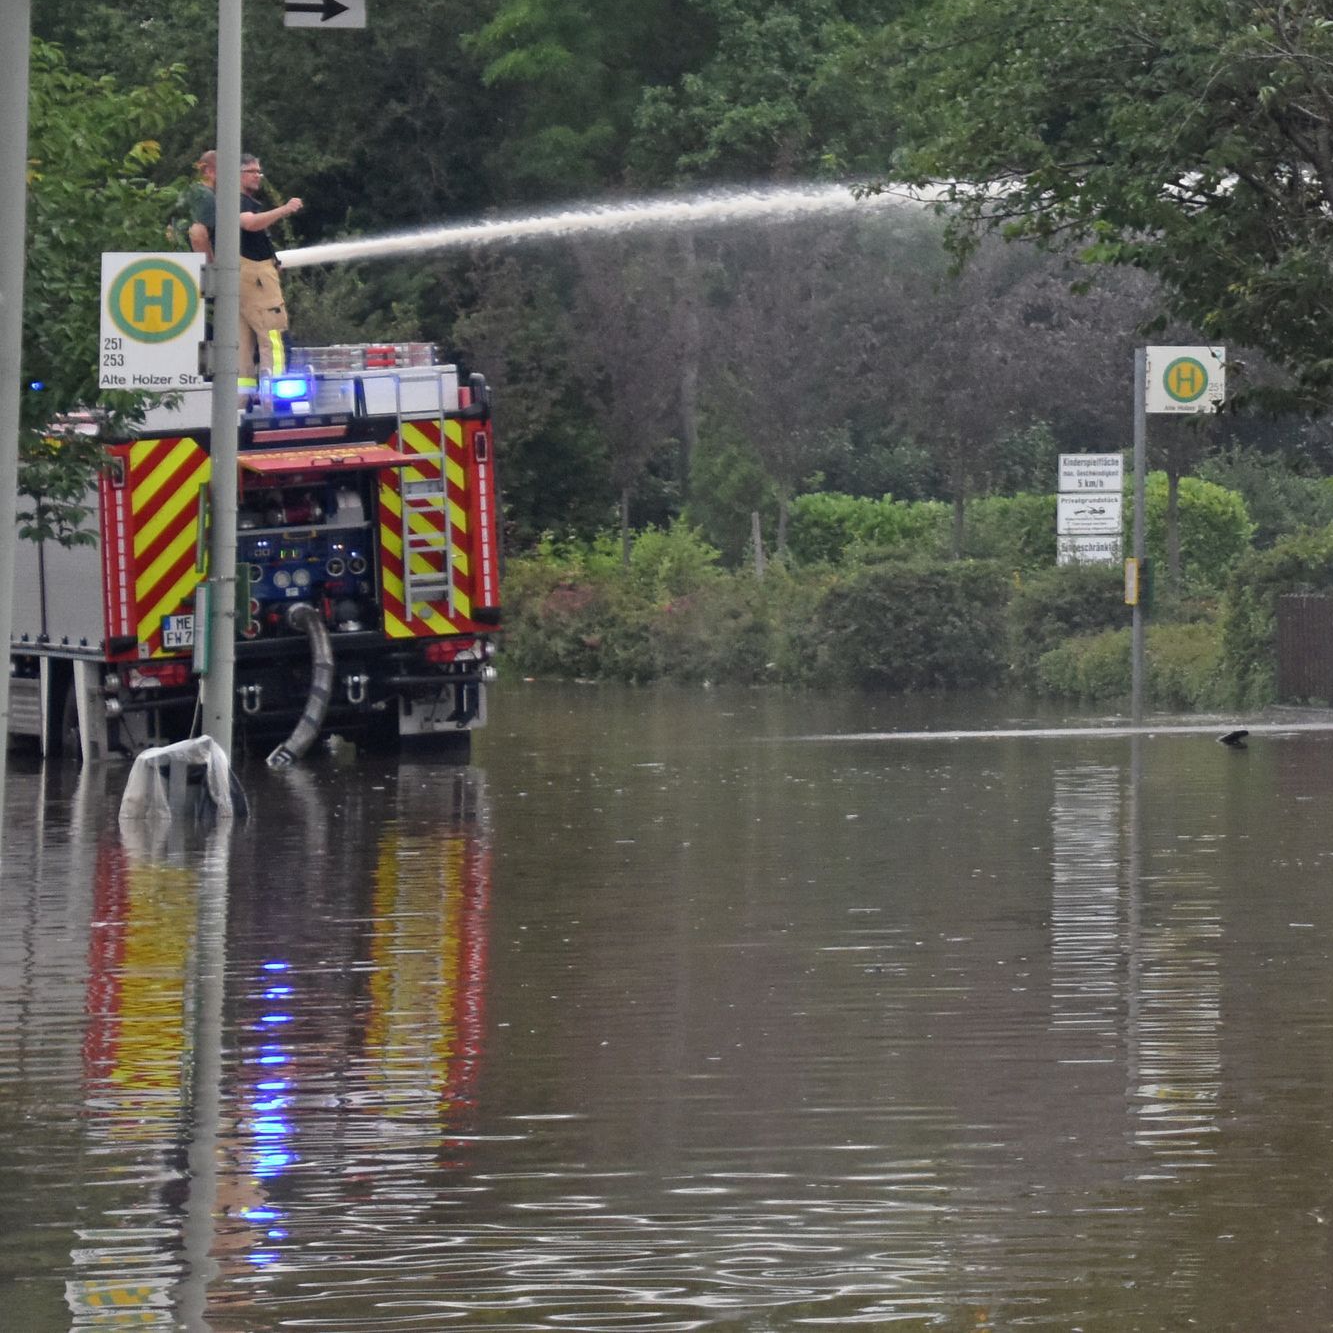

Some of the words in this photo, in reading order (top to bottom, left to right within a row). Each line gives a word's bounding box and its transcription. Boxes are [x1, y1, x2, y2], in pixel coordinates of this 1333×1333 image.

[132, 278, 174, 323] H
[104, 337, 122, 351] 251
[103, 353, 124, 367] 253
[101, 373, 126, 385] Alte
[132, 373, 172, 385] Holzer
[178, 373, 202, 385] Str.
[1176, 367, 1196, 394] H
[1077, 479, 1083, 488] 5
[1084, 479, 1104, 488] km/h
[176, 616, 192, 630] ME
